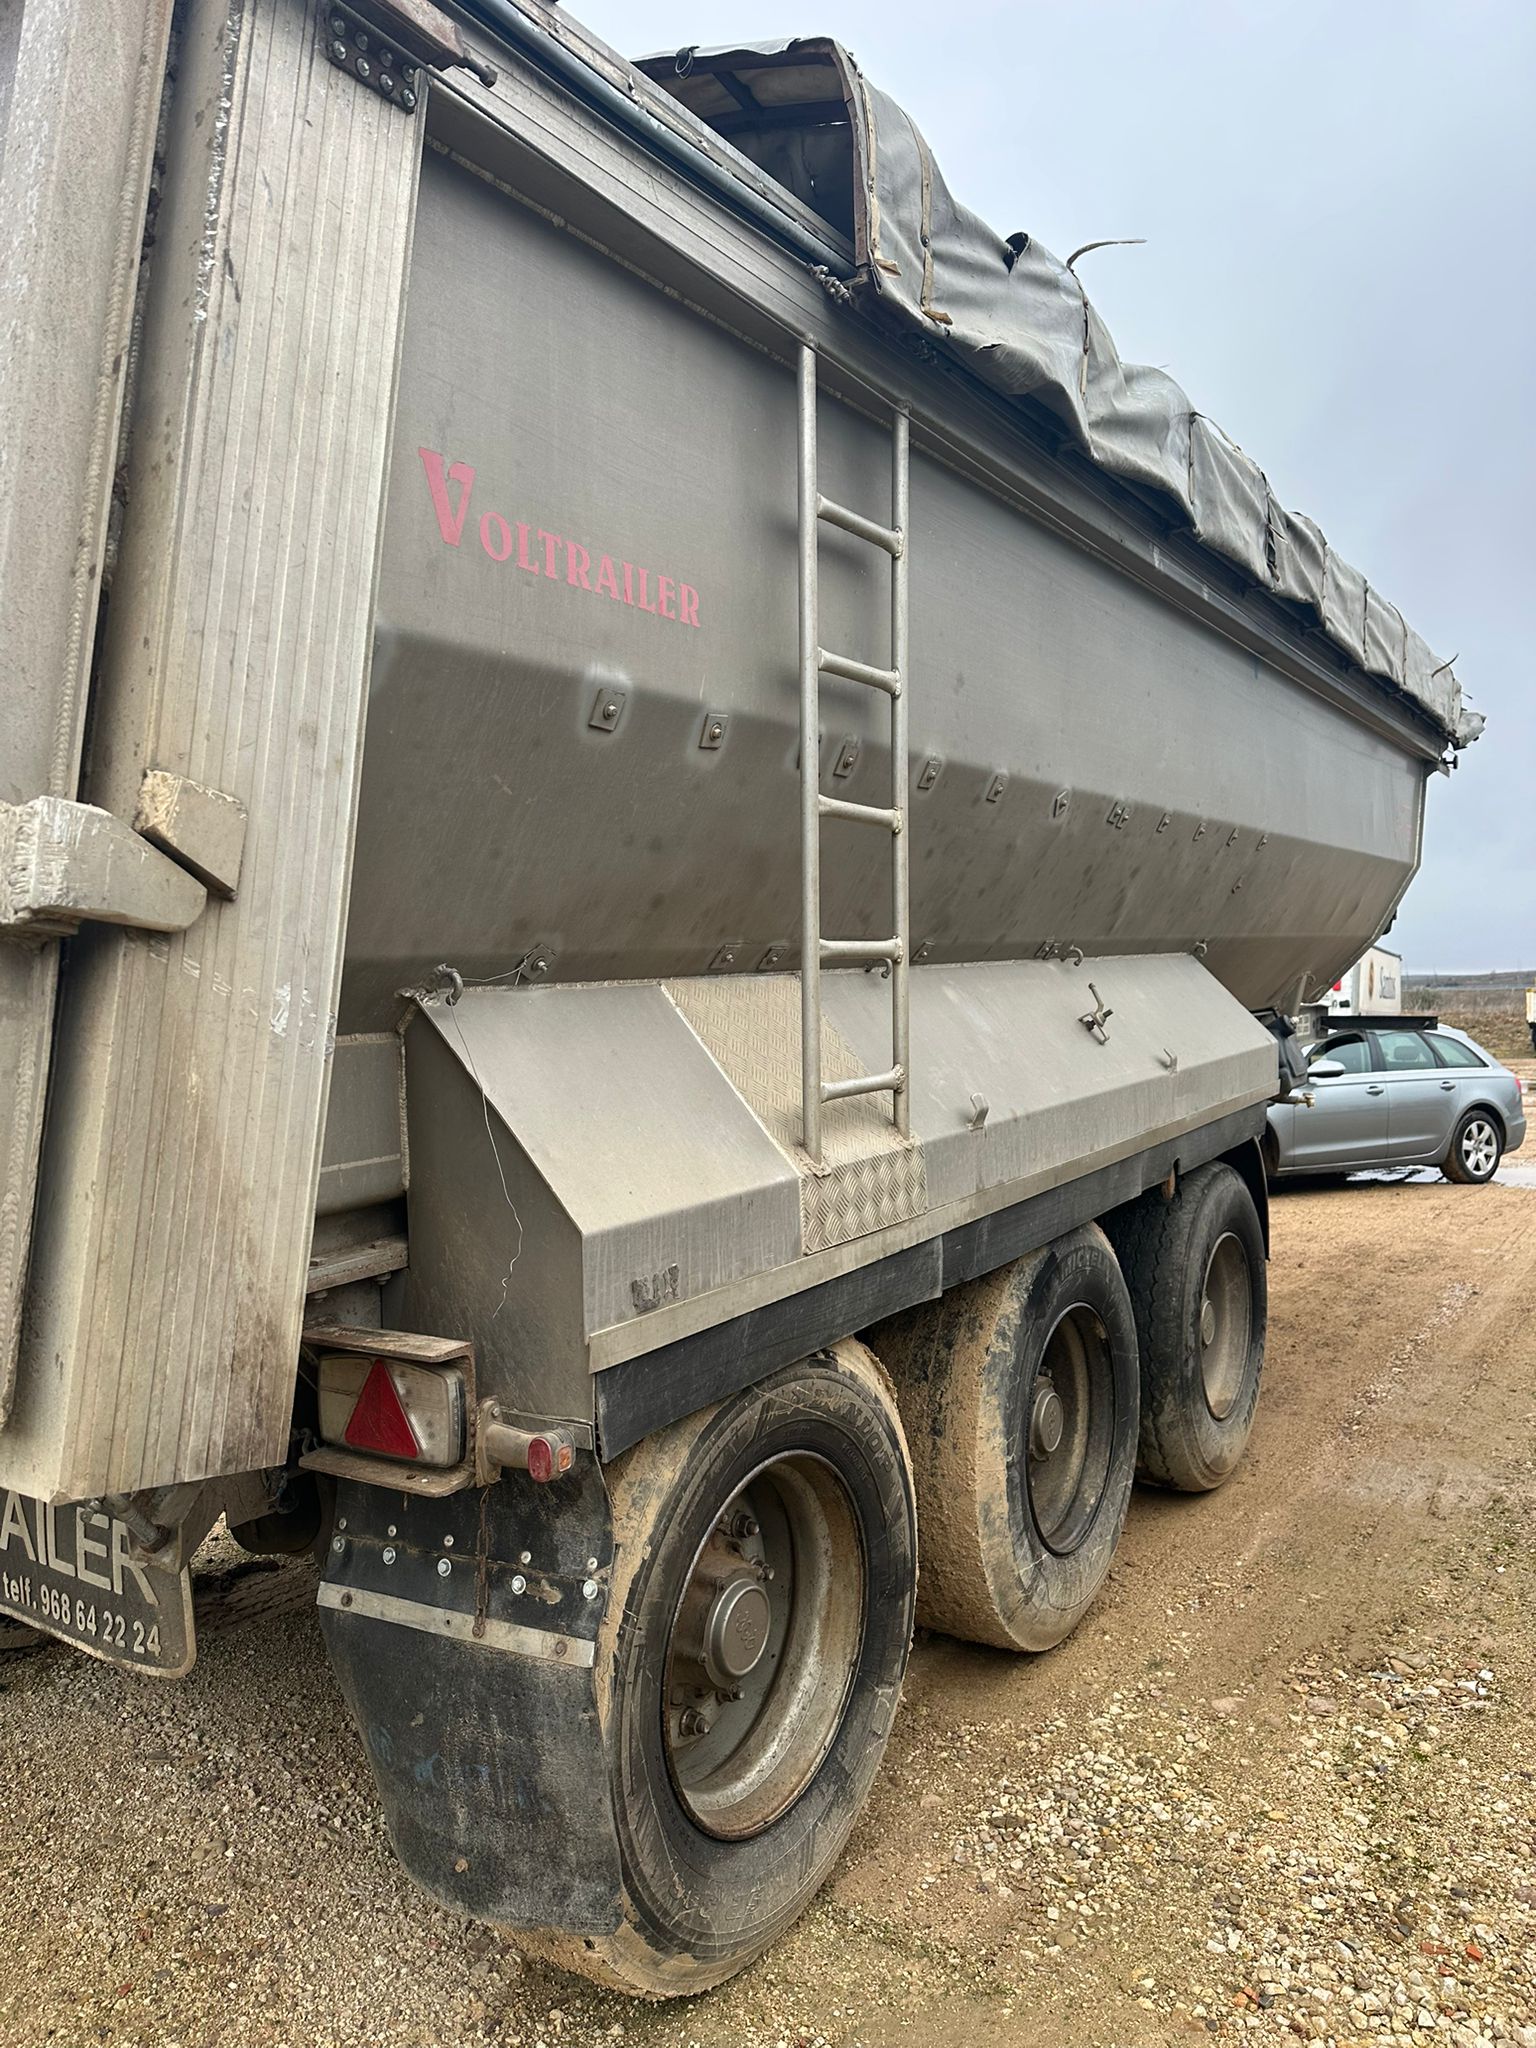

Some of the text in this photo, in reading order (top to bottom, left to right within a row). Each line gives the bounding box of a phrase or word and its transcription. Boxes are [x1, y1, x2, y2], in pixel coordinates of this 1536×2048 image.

[418, 446, 701, 628] VOLTRAILER
[2, 1571, 162, 1657] telf. 968 64 22 24
